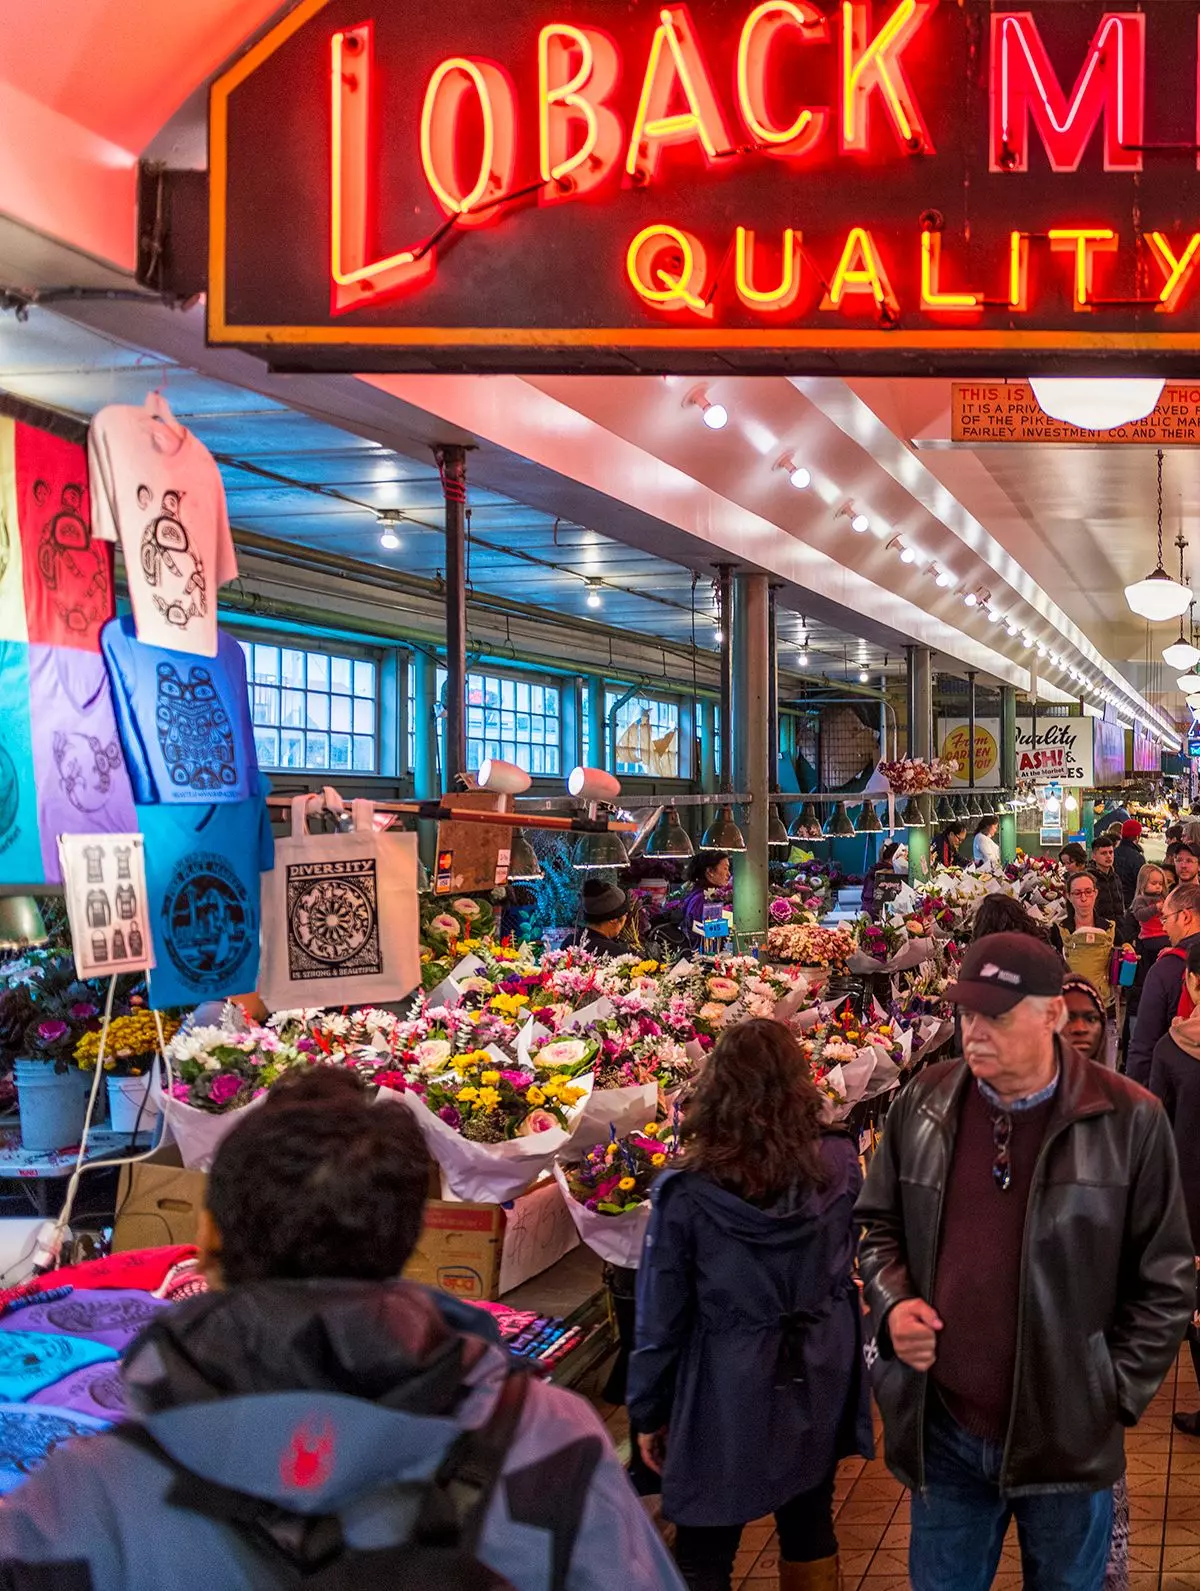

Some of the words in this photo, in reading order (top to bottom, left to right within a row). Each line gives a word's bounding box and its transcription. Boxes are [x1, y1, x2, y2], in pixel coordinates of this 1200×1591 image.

[959, 388, 998, 401] THIS
[1007, 389, 1025, 401] IS
[962, 404, 974, 414] IT
[978, 404, 991, 414] IS
[995, 404, 1003, 414] A
[961, 415, 980, 425] OF
[988, 415, 1013, 426] THE
[1020, 416, 1054, 426] PIKE
[1130, 417, 1171, 427] UBLIC
[962, 427, 1016, 437] FAIRLEY
[1108, 429, 1128, 438] CO.
[1132, 429, 1156, 438] AND
[1162, 429, 1195, 438] THEIR
[946, 748, 990, 761] GAREN
[1016, 750, 1063, 770] ASH!
[1042, 767, 1064, 775] Market
[290, 860, 374, 876] DIVERSITY
[303, 970, 331, 978] STRONG
[339, 966, 379, 976] BEAUTIFUL
